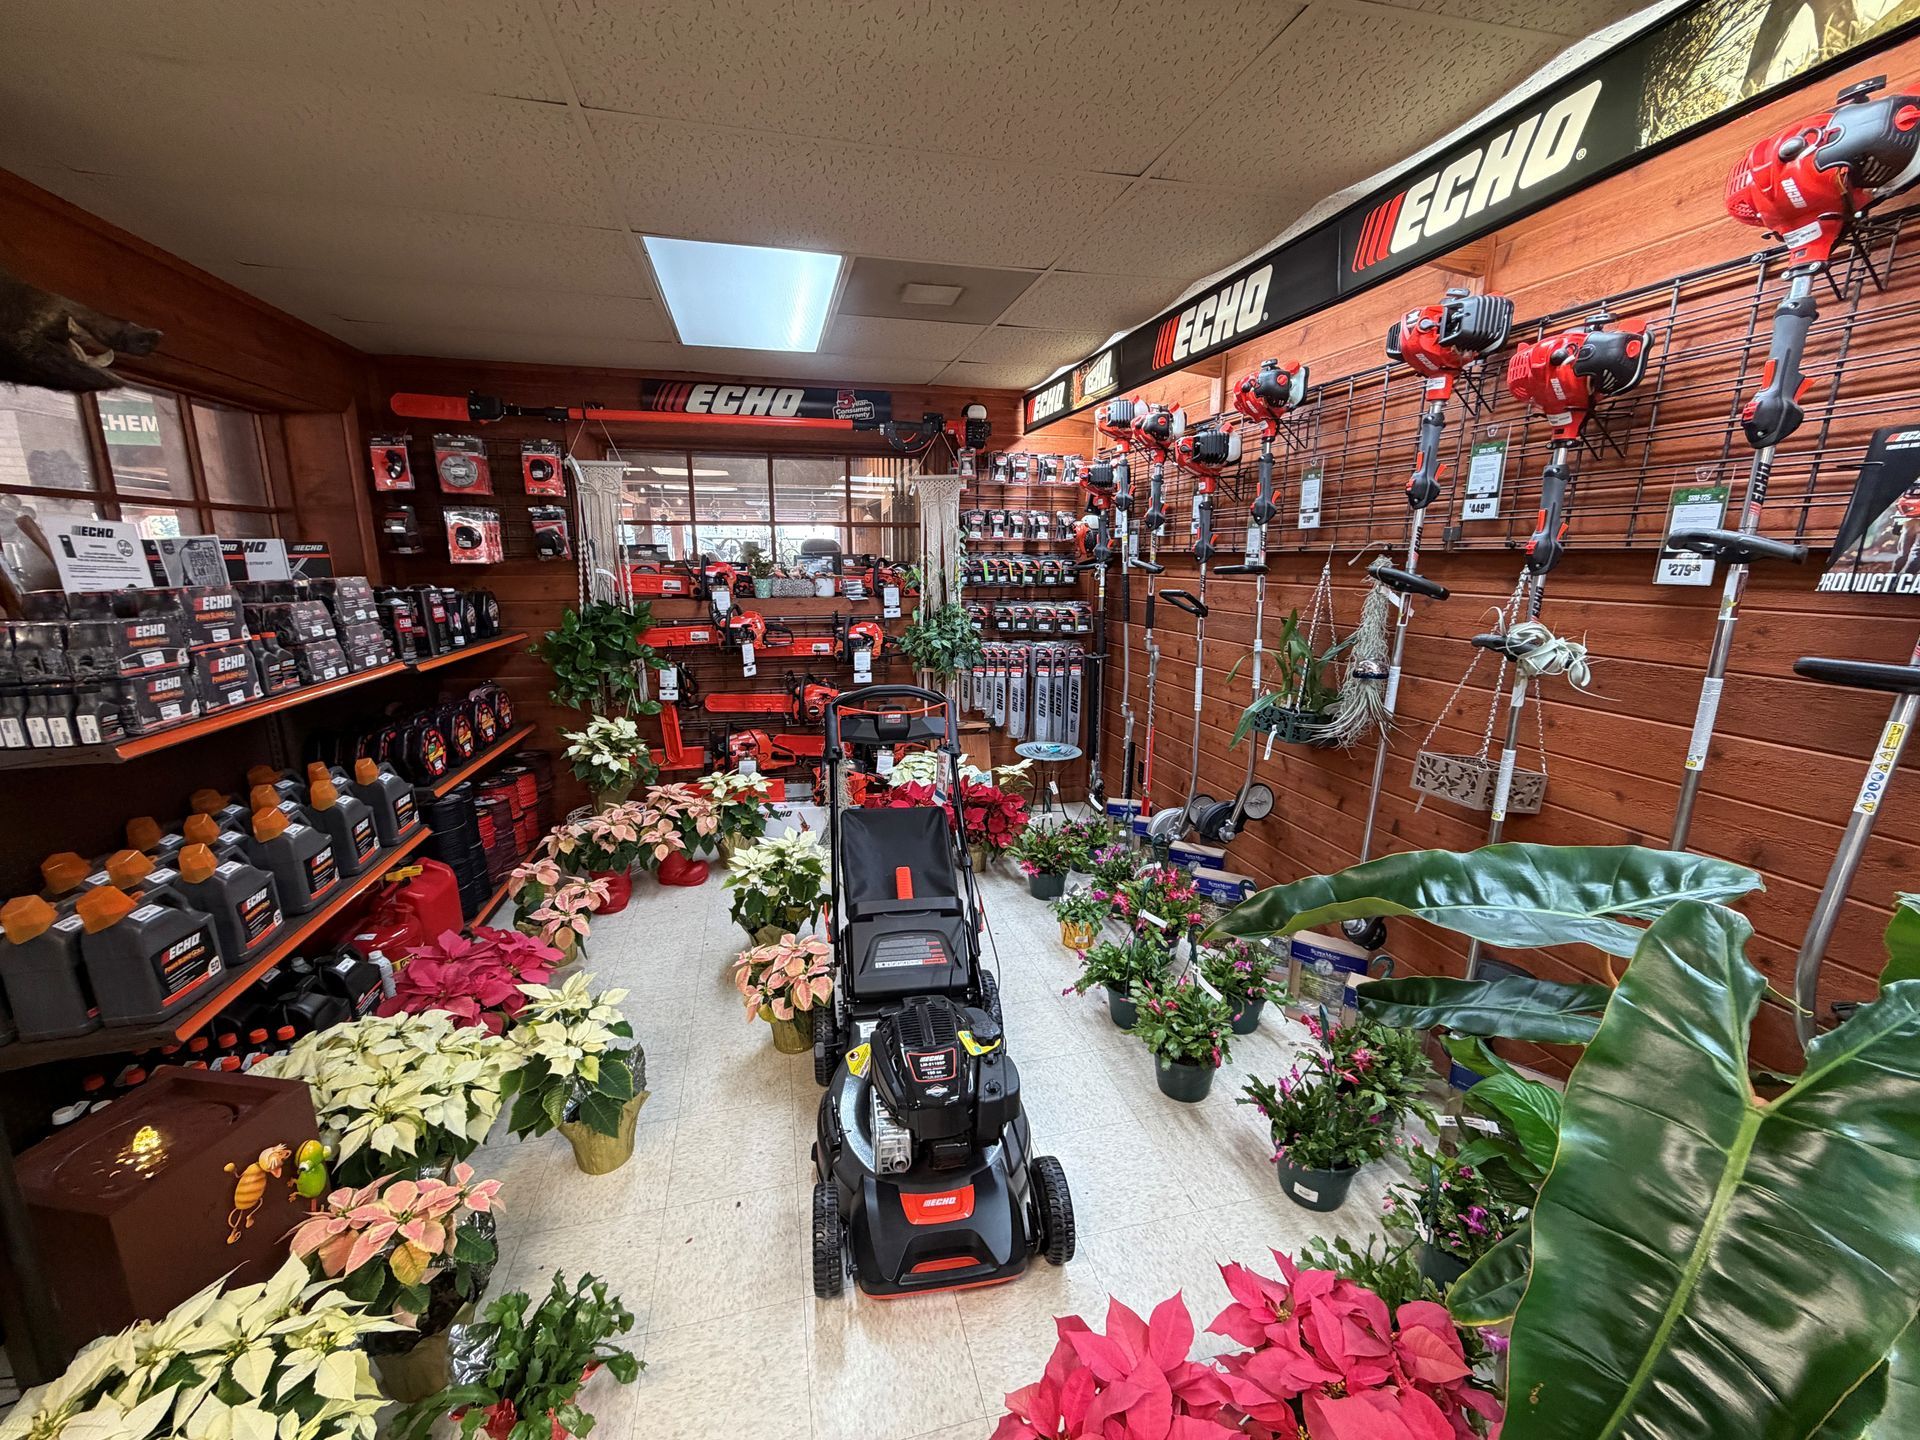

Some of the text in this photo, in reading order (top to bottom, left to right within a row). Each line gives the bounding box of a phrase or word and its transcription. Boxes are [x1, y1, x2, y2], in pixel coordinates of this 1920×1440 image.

[1390, 80, 1603, 253] ECHO
[1172, 264, 1273, 361] ECHO
[685, 384, 805, 417] ECHO
[837, 390, 856, 409] 5
[852, 400, 867, 408] year
[1033, 381, 1065, 422] ECHO
[836, 406, 871, 415] Consumer
[838, 412, 870, 420] Warranty
[81, 526, 114, 539] ECHO
[220, 543, 238, 551] CHO
[243, 542, 267, 553] HO
[1815, 573, 1897, 592] PRODUCT
[203, 595, 232, 610] ECHO
[136, 623, 165, 638] ECHO
[218, 653, 246, 672] ECHO
[156, 676, 181, 692] ECHO
[1038, 692, 1047, 718] ECHO
[1071, 686, 1079, 714] ECHO
[247, 887, 267, 910] ECHO
[169, 932, 200, 960] ECHO
[930, 1196, 957, 1206] ECHO
